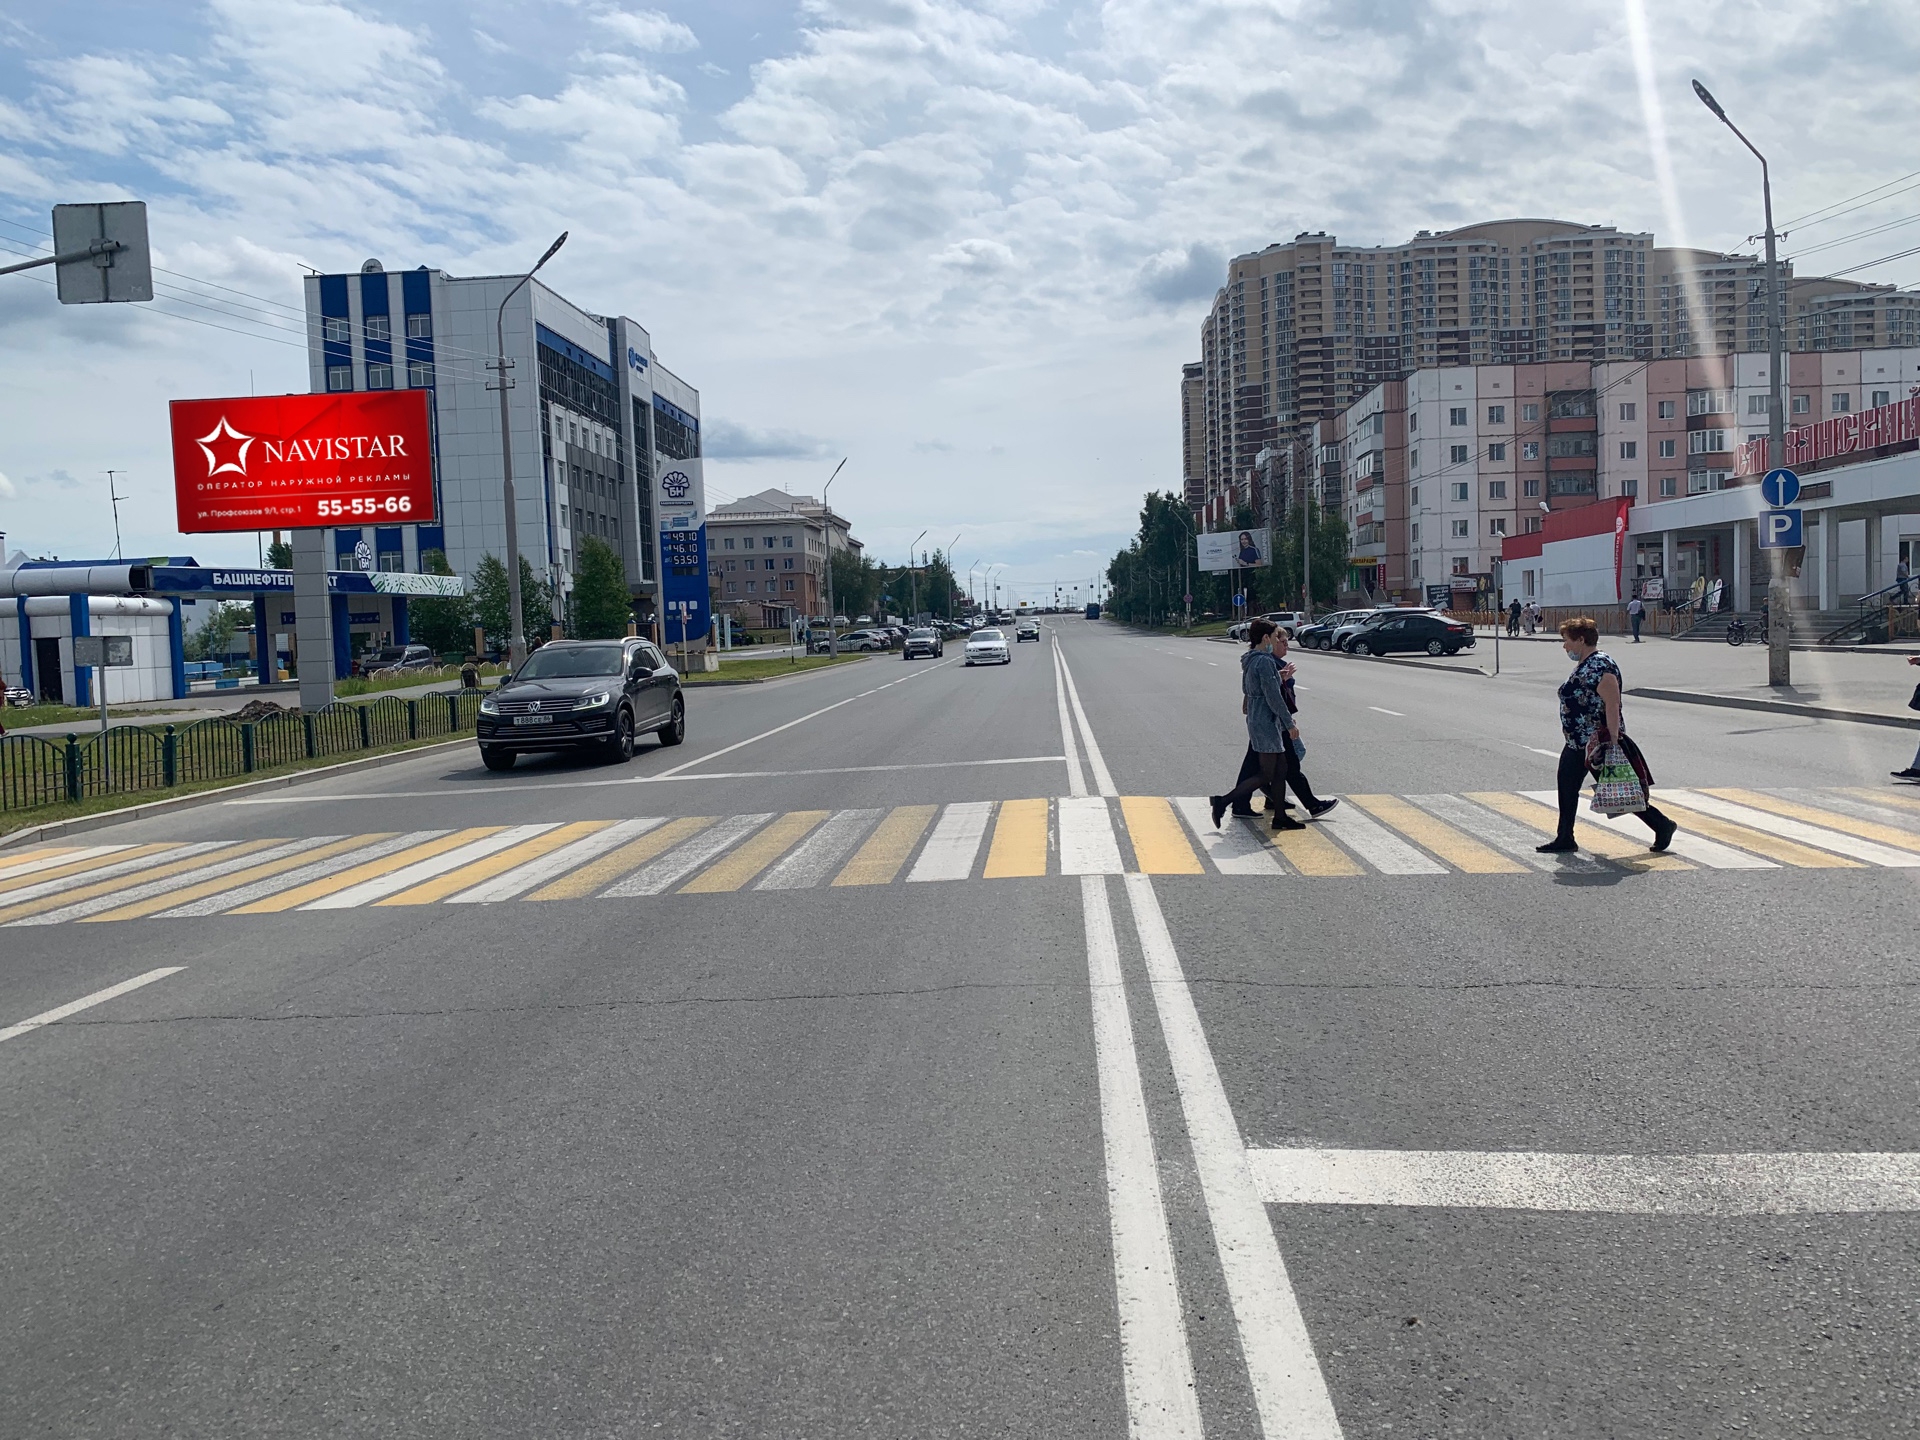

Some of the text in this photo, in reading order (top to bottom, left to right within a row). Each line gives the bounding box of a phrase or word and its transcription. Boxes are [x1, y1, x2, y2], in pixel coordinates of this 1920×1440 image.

[1733, 385, 1920, 477] СЛВЯНСКИЙ
[262, 434, 409, 463] NAVISTAR
[197, 473, 411, 491] ОПЕРАТОР НАРУЖНОЙ РЕКЛАМЫ
[670, 486, 684, 497] БН
[317, 496, 412, 516] 55-55-66
[197, 511, 210, 519] ул.
[211, 507, 263, 518] Профсоюзов
[280, 507, 296, 516] стр.
[1769, 514, 1793, 543] P
[672, 532, 697, 542] 49.10
[673, 543, 698, 553] 46.10
[361, 559, 370, 569] БН
[673, 555, 698, 565] 53.50
